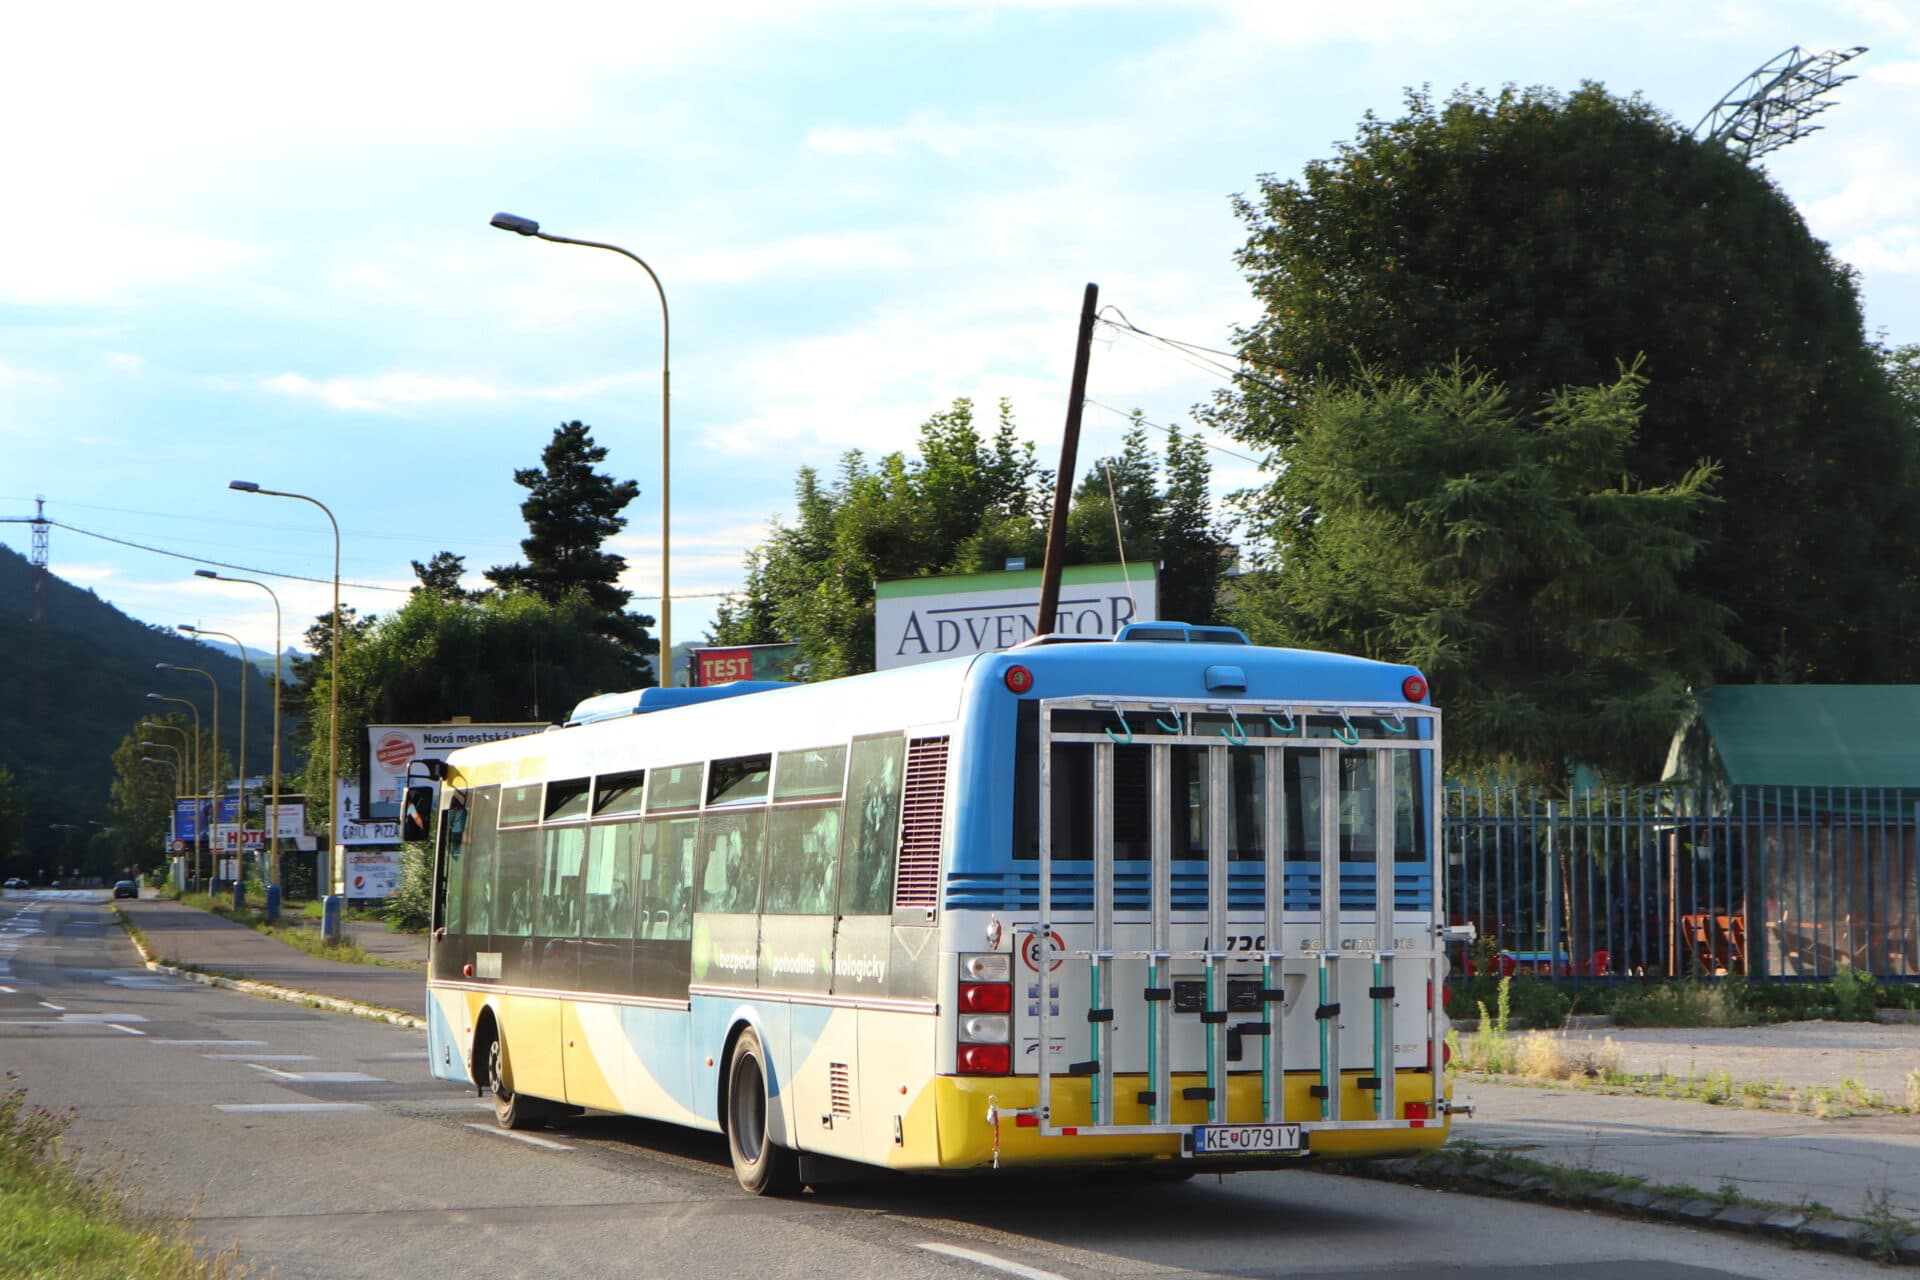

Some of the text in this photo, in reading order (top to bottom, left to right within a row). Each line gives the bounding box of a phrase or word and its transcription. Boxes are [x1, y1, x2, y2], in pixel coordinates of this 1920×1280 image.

[703, 658, 748, 678] TEST
[424, 733, 454, 744] Nová
[720, 950, 759, 974] bezpečn
[1207, 1128, 1297, 1148] KE 079IY
